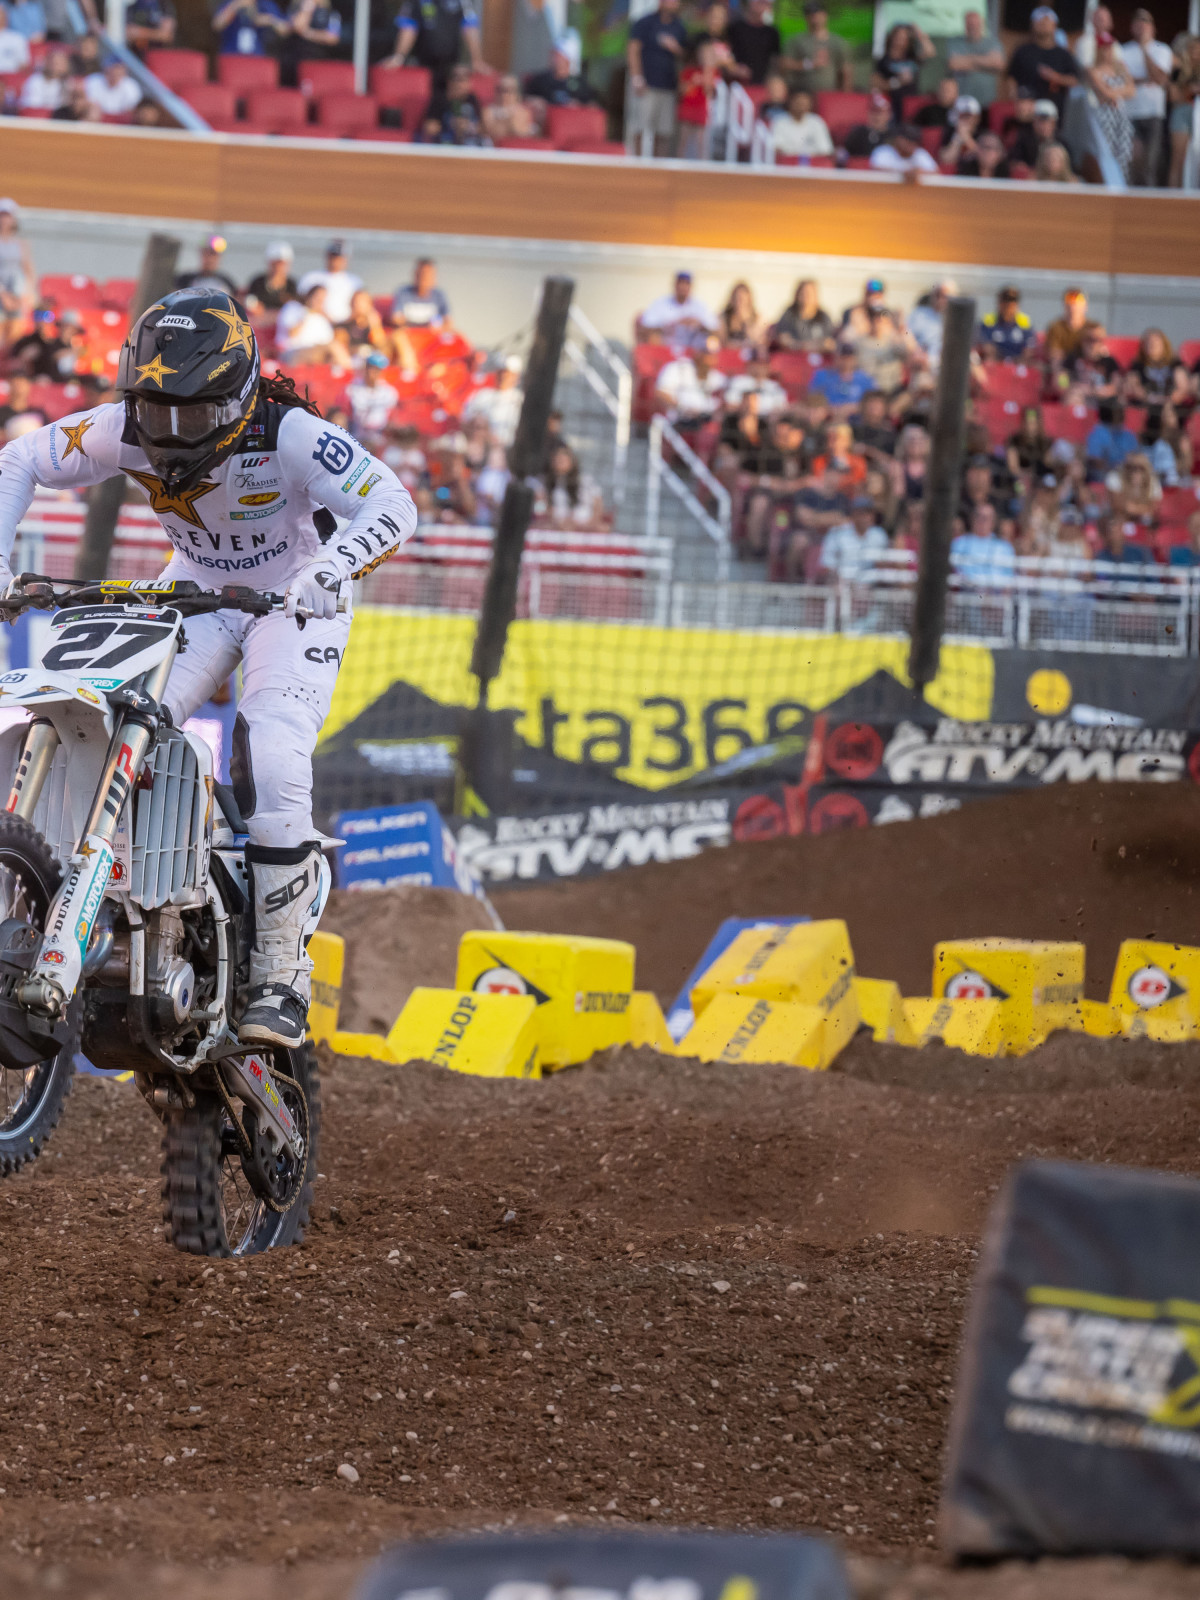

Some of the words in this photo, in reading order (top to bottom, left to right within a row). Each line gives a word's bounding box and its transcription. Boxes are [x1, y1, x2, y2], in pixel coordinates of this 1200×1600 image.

[162, 316, 191, 327] SHOEI
[241, 456, 270, 468] WP
[243, 500, 284, 519] MOTOREX
[166, 524, 267, 551] SEVEN
[176, 538, 289, 573] Husqvarna
[337, 513, 401, 566] SVEN
[41, 622, 174, 671] 27
[53, 868, 82, 933] DUNLOP
[81, 855, 113, 925] MOTOREX
[432, 996, 479, 1067] UNLOP
[721, 999, 773, 1060] UNLOP
